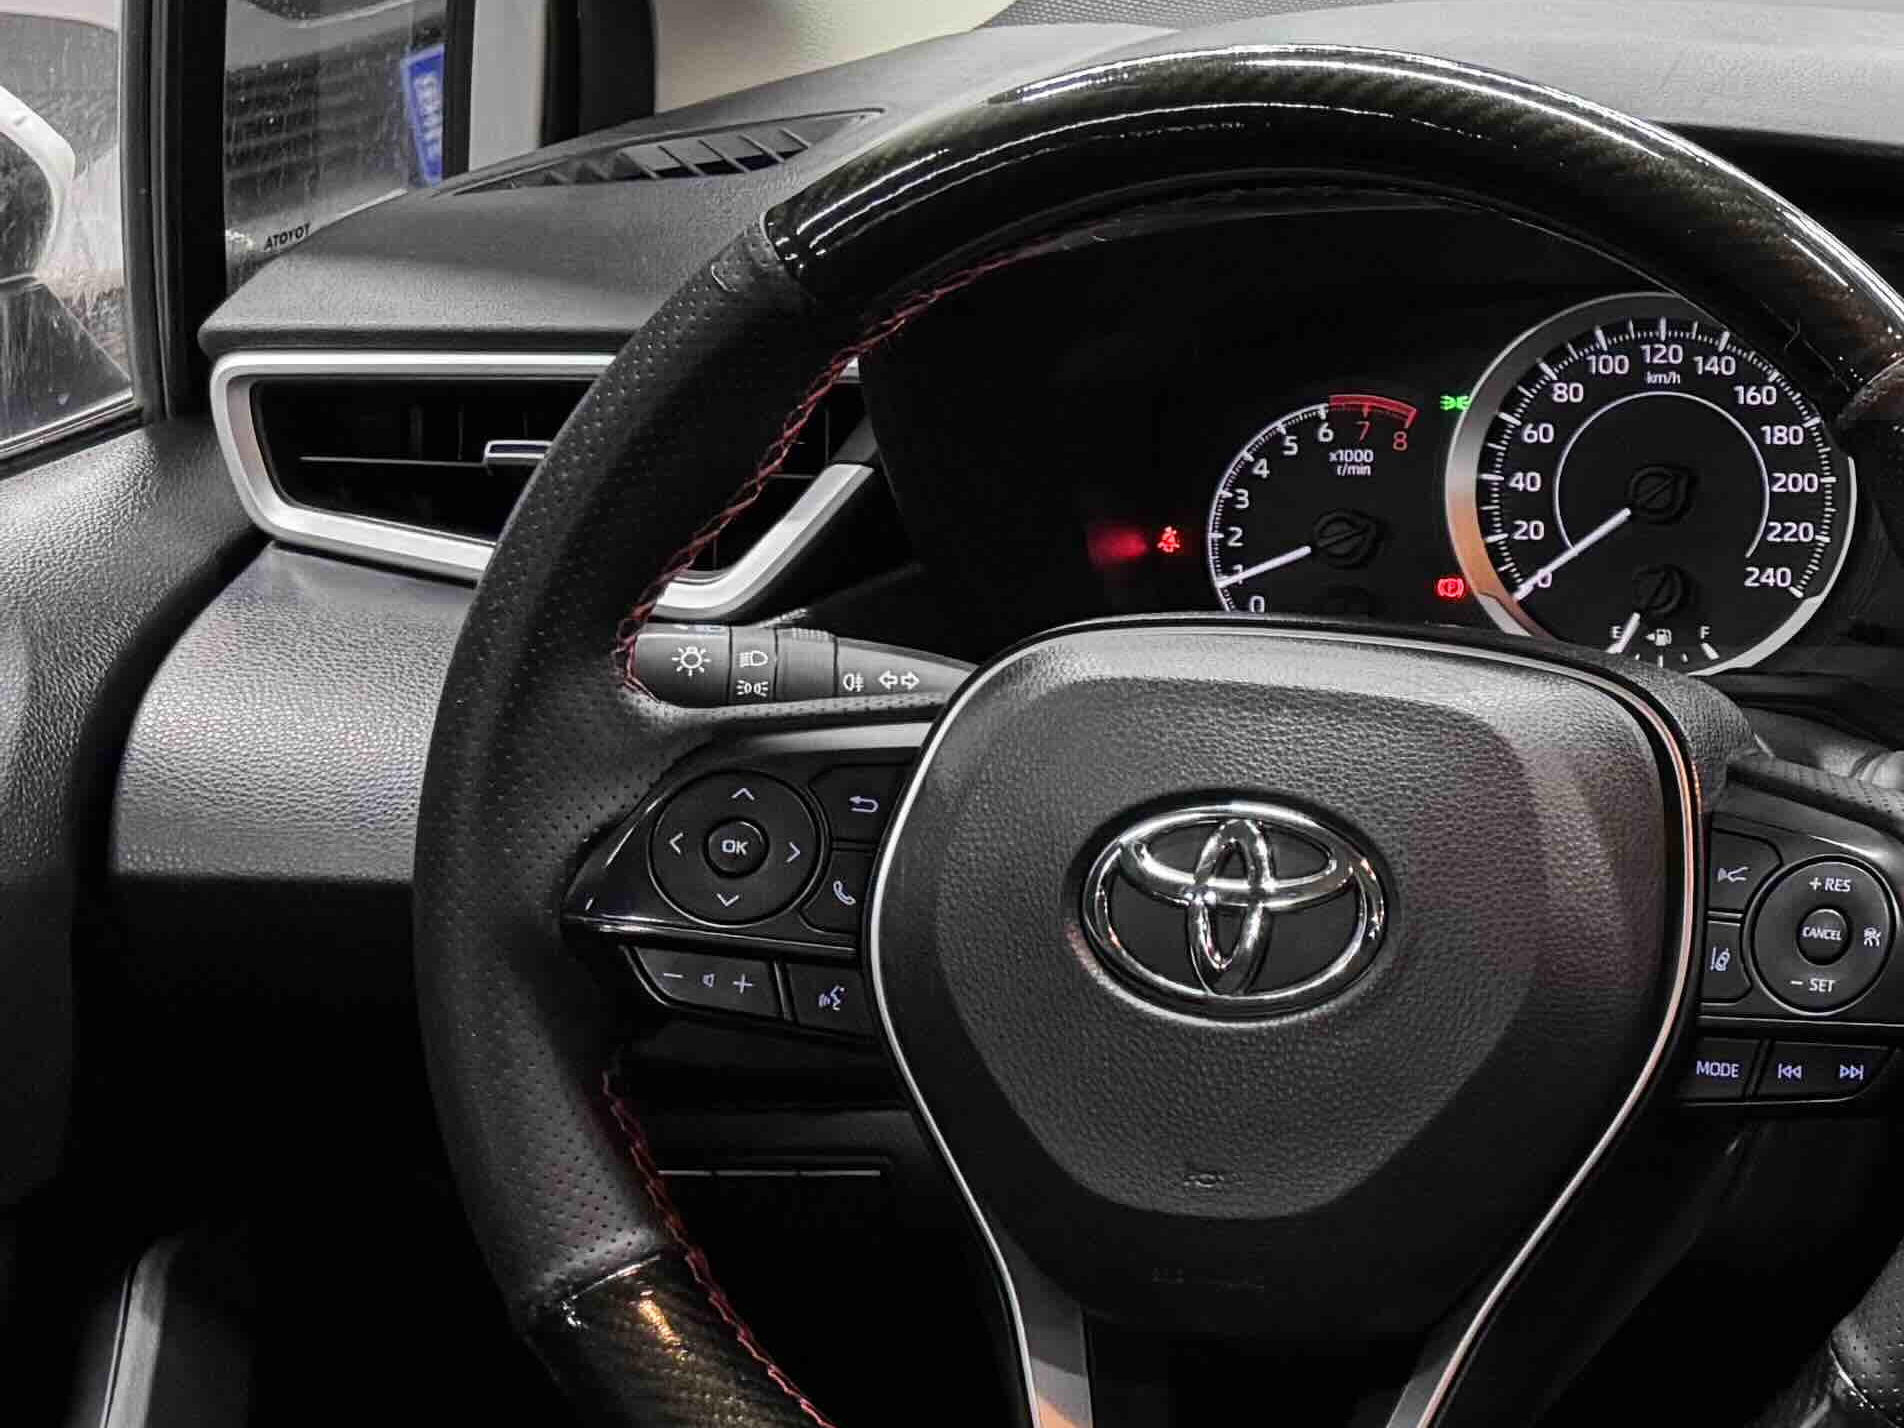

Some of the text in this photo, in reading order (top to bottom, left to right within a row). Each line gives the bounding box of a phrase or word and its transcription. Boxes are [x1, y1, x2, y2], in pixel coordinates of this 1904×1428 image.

[1640, 343, 1684, 364] 120
[1586, 355, 1630, 375] 100
[1693, 355, 1736, 376] 140
[1646, 371, 1682, 384] km/h
[1552, 383, 1584, 403] 80
[1733, 385, 1777, 406] 160
[1317, 422, 1334, 443] 6
[1355, 421, 1371, 441] 7
[1392, 429, 1409, 451] 8
[1523, 423, 1554, 444] 60
[1760, 425, 1804, 445] 180
[1282, 435, 1299, 456] 5
[1328, 448, 1375, 464] x1000
[1252, 458, 1270, 479] 4
[1336, 464, 1372, 477] r/min
[1508, 471, 1542, 492] 40
[1771, 472, 1819, 493] 200
[1234, 488, 1250, 509] 3
[1226, 526, 1243, 547] 2
[1512, 520, 1545, 541] 20
[1765, 522, 1815, 543] 220
[1743, 566, 1792, 588] 240
[1611, 625, 1623, 641] E
[1699, 625, 1711, 641] F
[721, 839, 748, 855] OK
[1824, 877, 1852, 893] RES
[1802, 926, 1842, 941] CANCEL
[1808, 977, 1836, 993] SET
[1696, 1060, 1740, 1078] MODE
